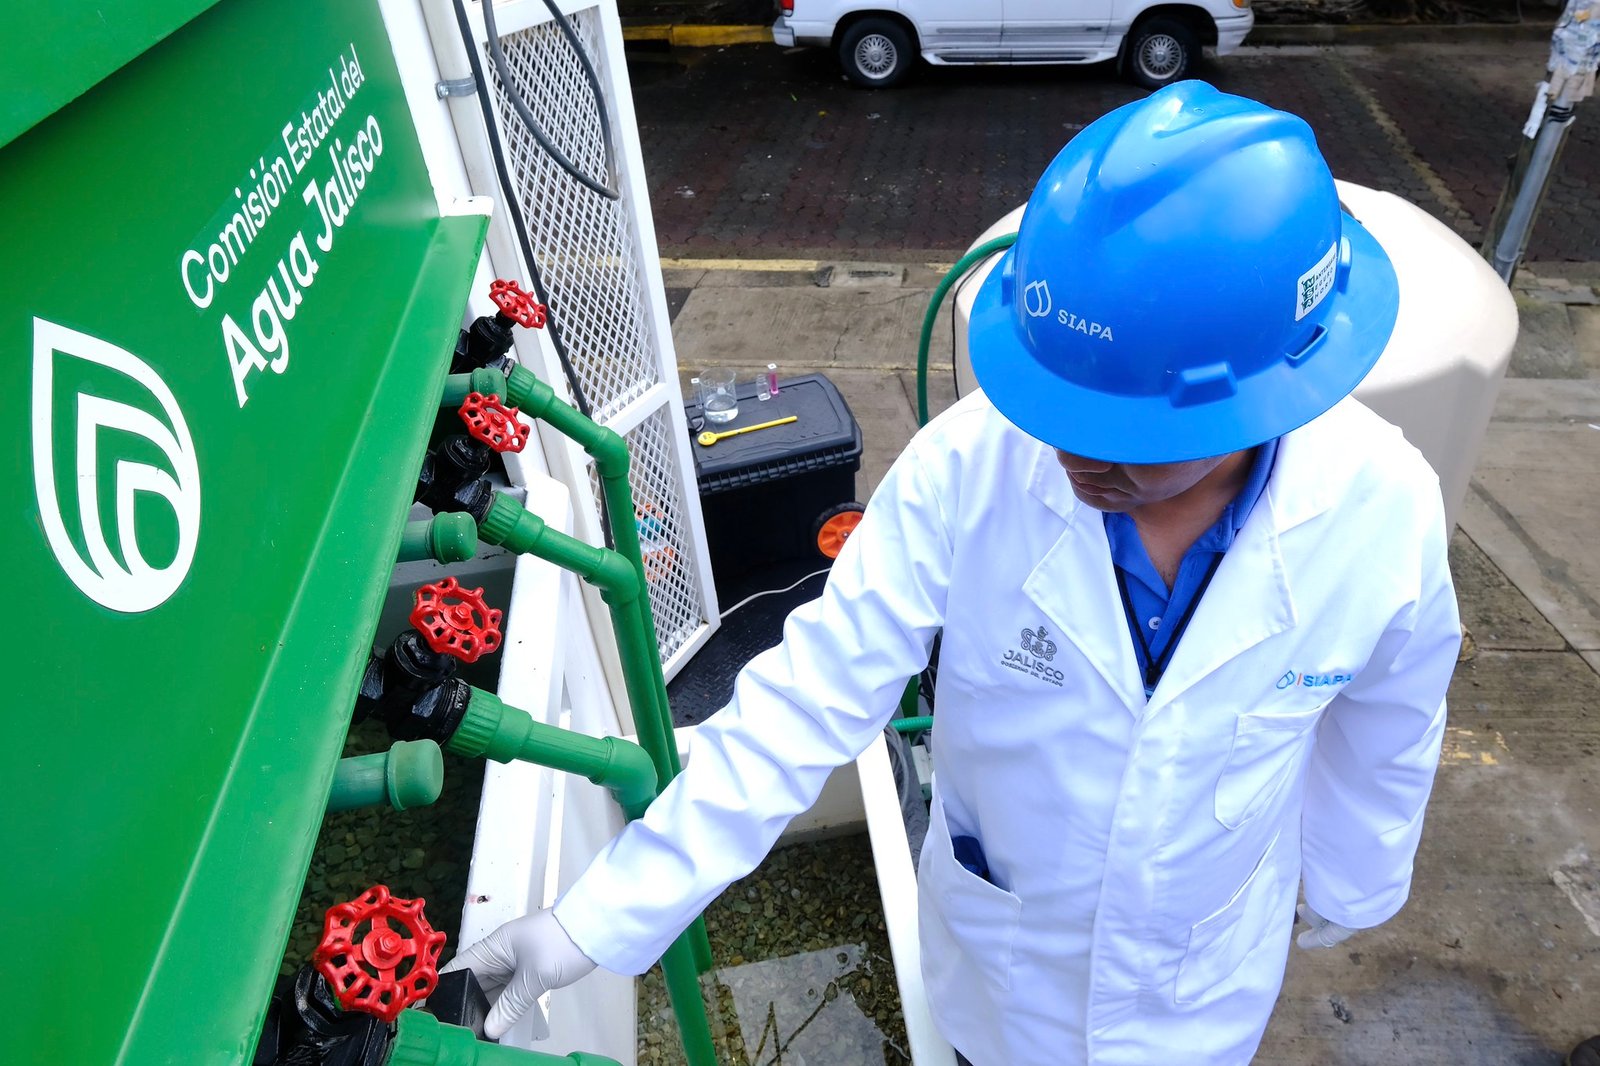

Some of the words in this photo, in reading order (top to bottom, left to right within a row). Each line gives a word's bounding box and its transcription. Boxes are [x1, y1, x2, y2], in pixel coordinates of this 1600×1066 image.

[181, 156, 293, 309] Comisión
[281, 67, 346, 175] Estatal
[340, 43, 365, 100] del
[221, 231, 320, 409] Agua
[302, 115, 383, 252] Jalisco
[1057, 308, 1114, 342] SIAPA
[1003, 649, 1065, 681] JALISCO
